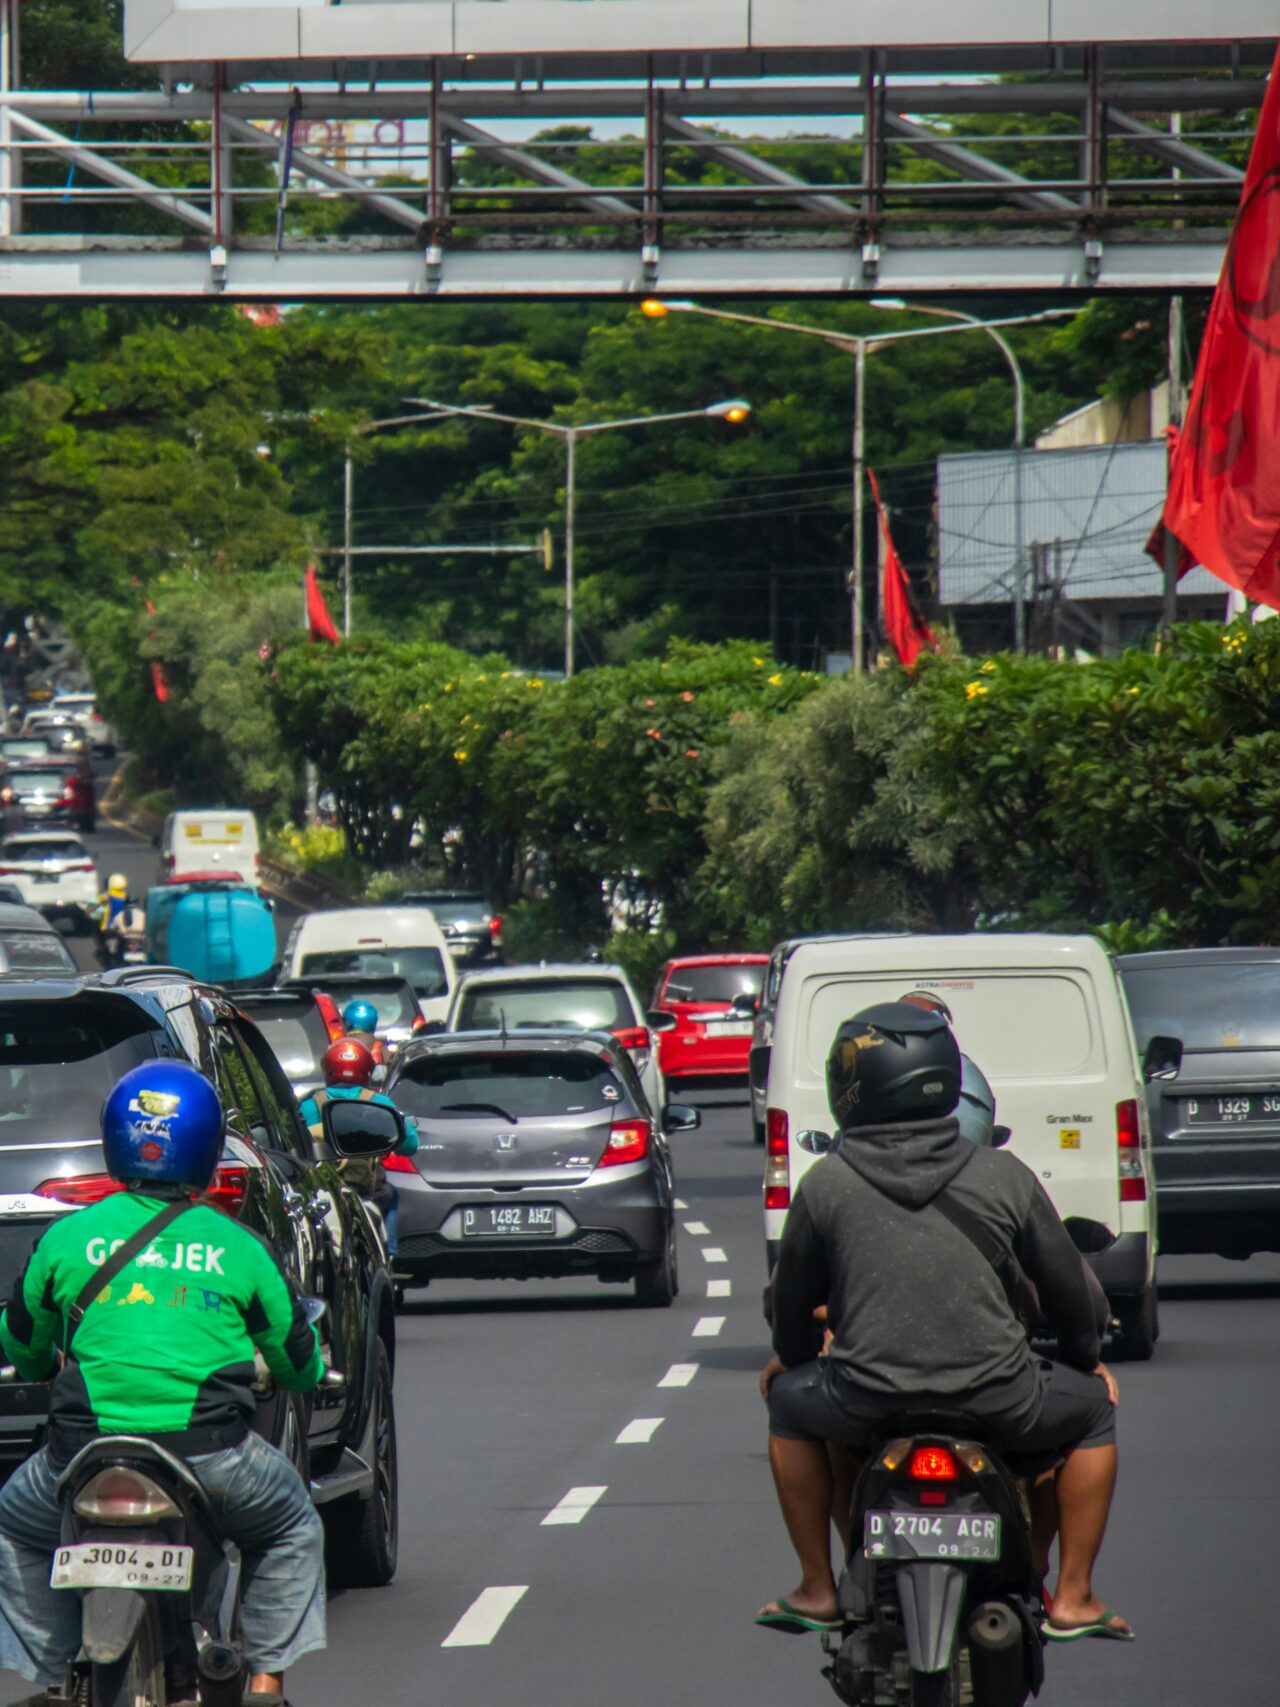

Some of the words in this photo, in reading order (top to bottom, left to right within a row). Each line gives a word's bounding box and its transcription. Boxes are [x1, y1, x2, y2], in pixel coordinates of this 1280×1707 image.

[1188, 1098, 1199, 1115] D
[1217, 1097, 1251, 1114] 1329
[1046, 1114, 1071, 1124] Gran
[1072, 1114, 1093, 1123] Max
[465, 1209, 475, 1226] D
[490, 1208, 523, 1225] 1482
[527, 1208, 553, 1224] AHZ
[171, 1242, 227, 1276] JEK
[870, 1515, 884, 1535] D
[894, 1516, 943, 1536] 2704
[957, 1518, 996, 1539] ACR
[58, 1550, 71, 1567] D
[88, 1548, 139, 1566] 3004
